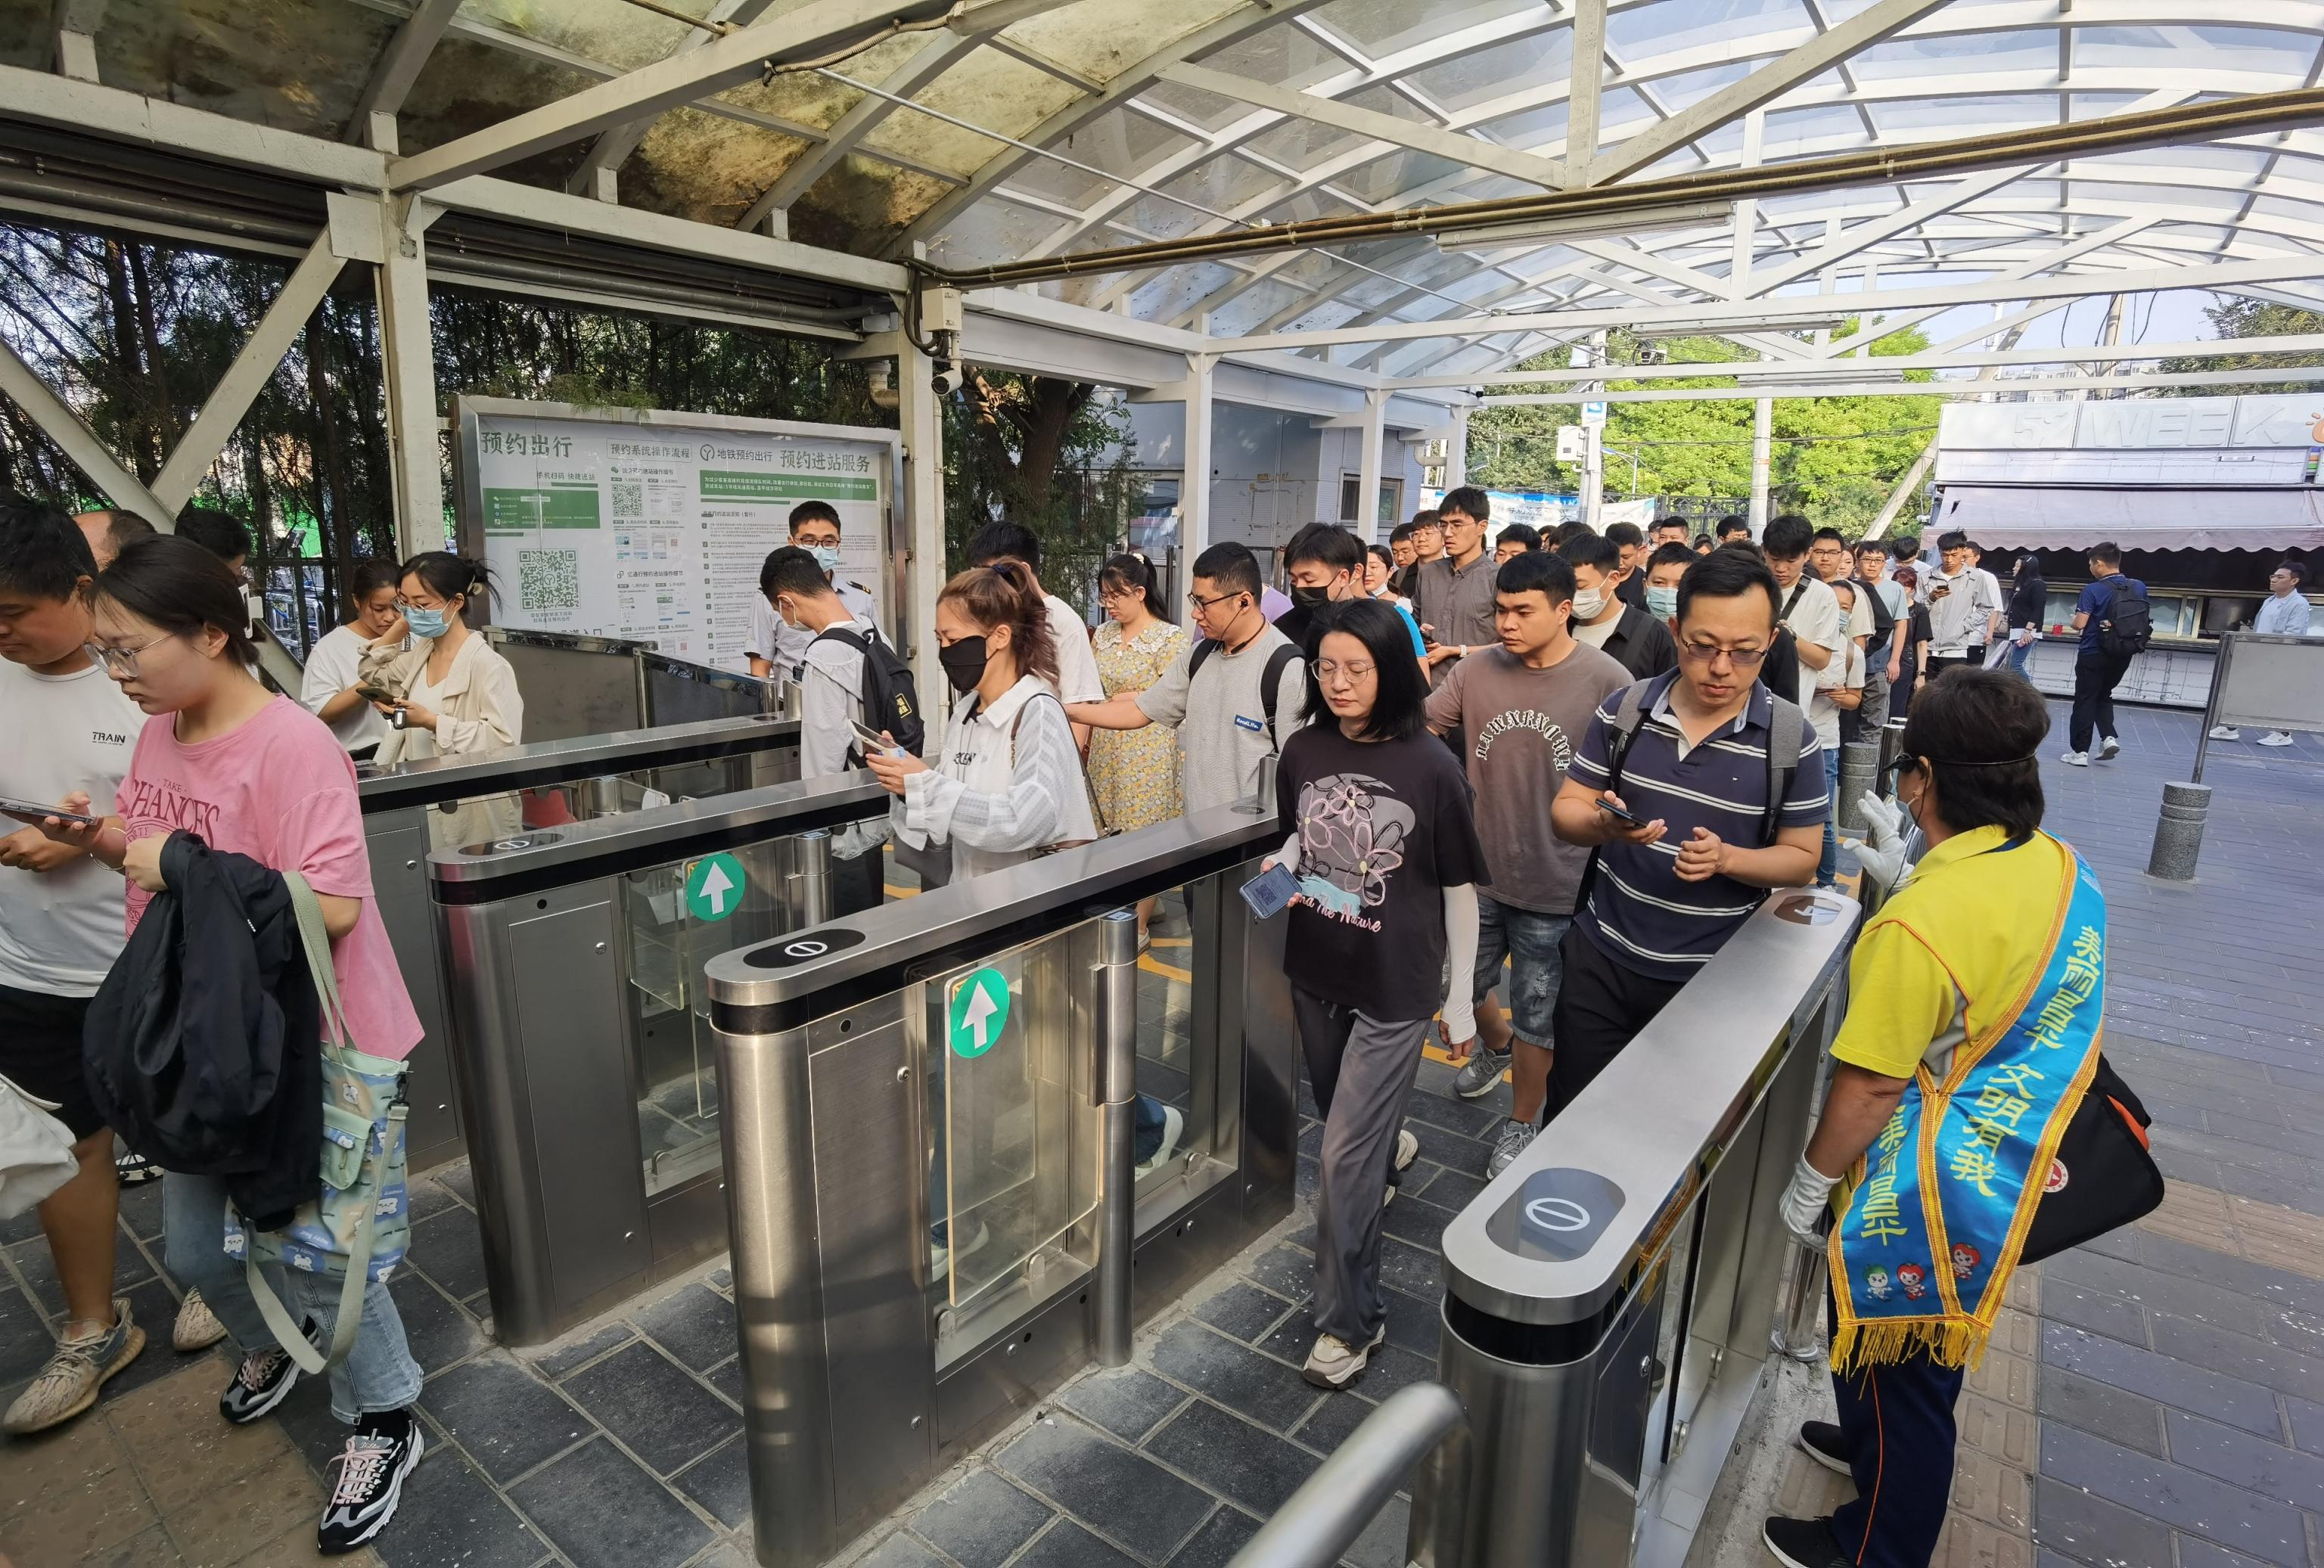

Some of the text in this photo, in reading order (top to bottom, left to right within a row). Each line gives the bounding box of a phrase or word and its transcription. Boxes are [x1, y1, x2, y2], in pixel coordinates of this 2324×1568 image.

[2093, 405, 2285, 448] WEEK
[480, 431, 573, 458] 预约出行
[611, 443, 690, 458] 预约系统操作流程
[717, 448, 773, 462] 地铁预约出行
[780, 450, 871, 473] 预约进站服务
[92, 731, 126, 744] TRAIN
[163, 778, 182, 793] TAKE
[1340, 902, 1382, 933] Nature
[1950, 1063, 2045, 1197] 文明有我
